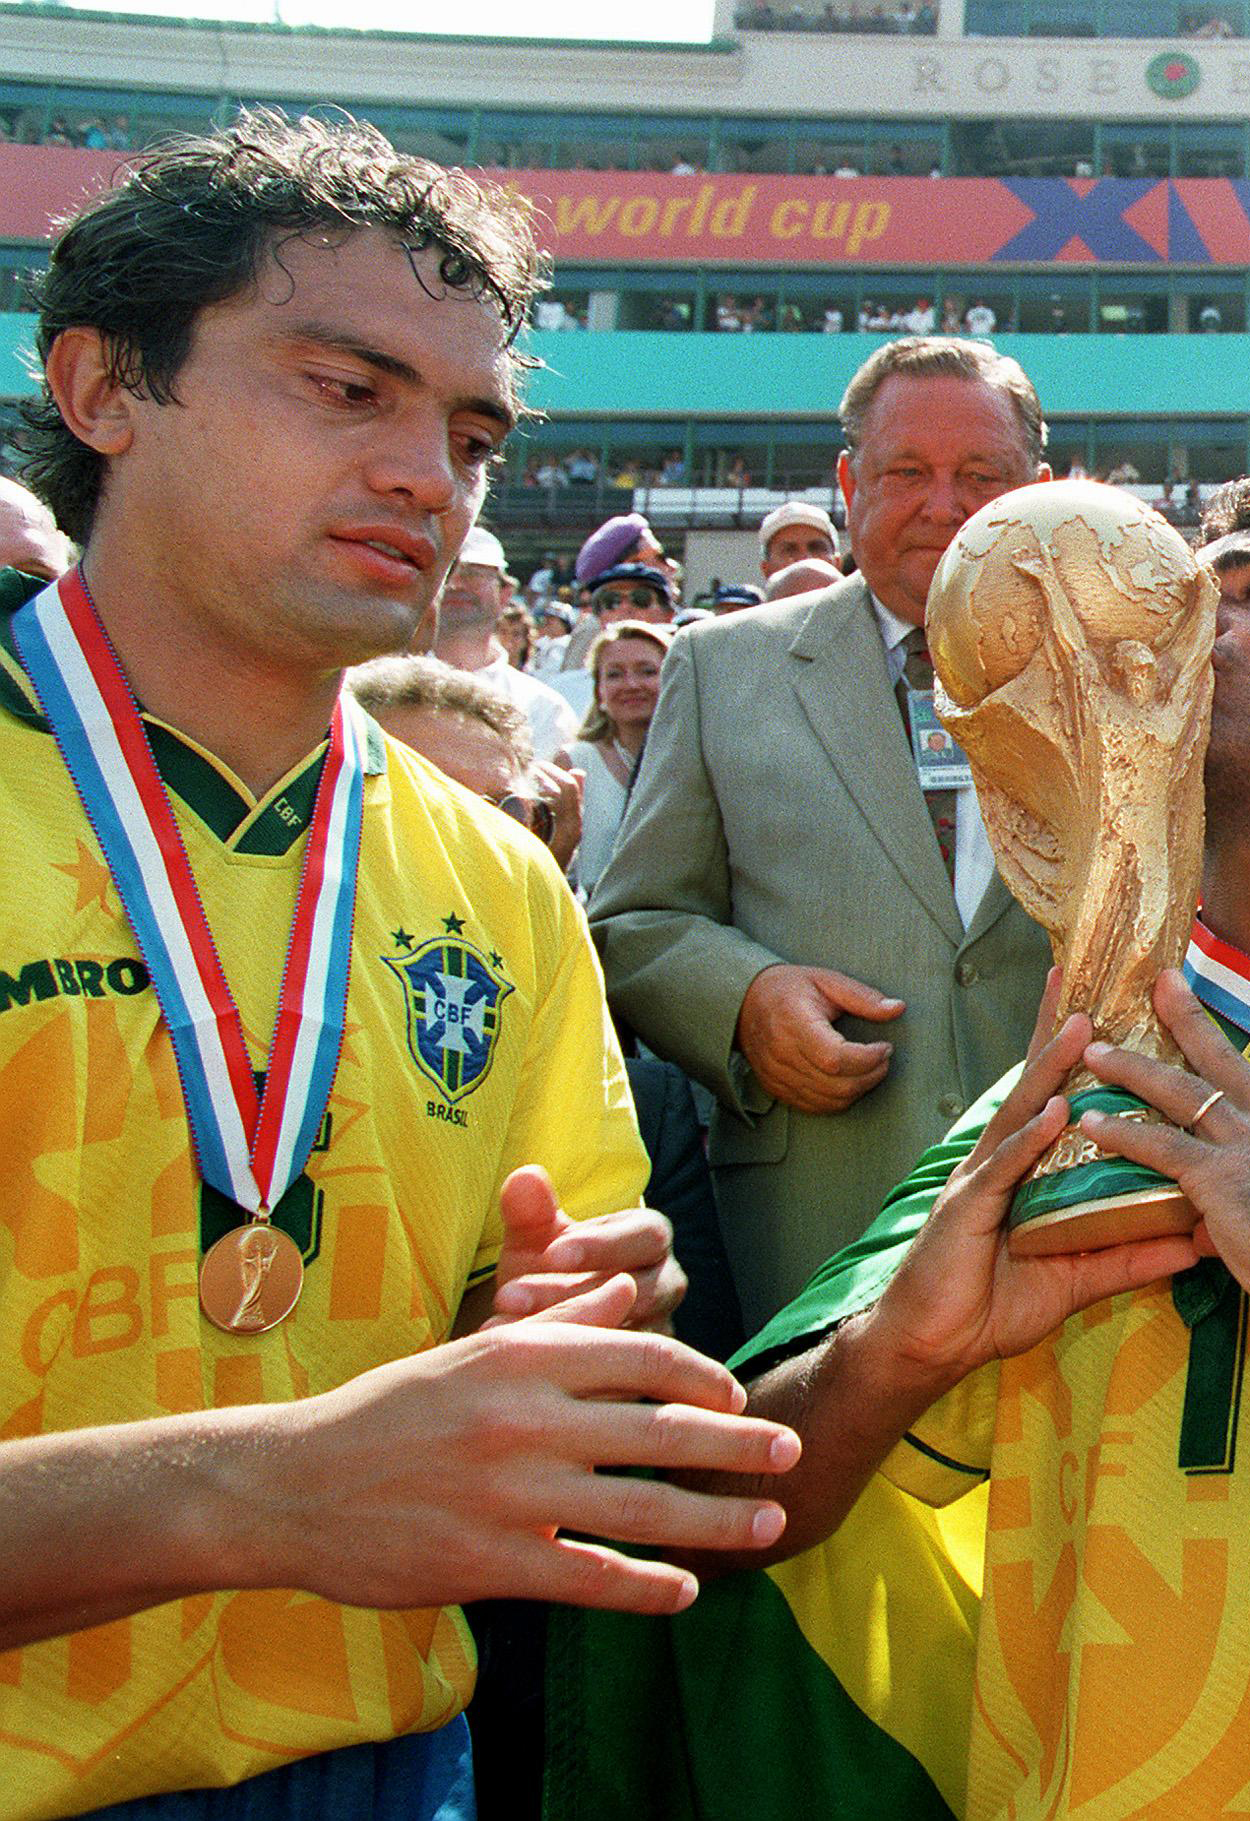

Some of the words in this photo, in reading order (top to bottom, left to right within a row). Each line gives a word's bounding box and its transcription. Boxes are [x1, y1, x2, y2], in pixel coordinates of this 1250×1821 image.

[912, 56, 1120, 96] ROSE
[555, 184, 757, 238] world
[770, 197, 892, 255] cup
[273, 797, 303, 828] CBF
[0, 957, 151, 1014] MBRO
[434, 1000, 473, 1026] CBF
[426, 1100, 468, 1129] BRASIL
[21, 1250, 198, 1378] CBF
